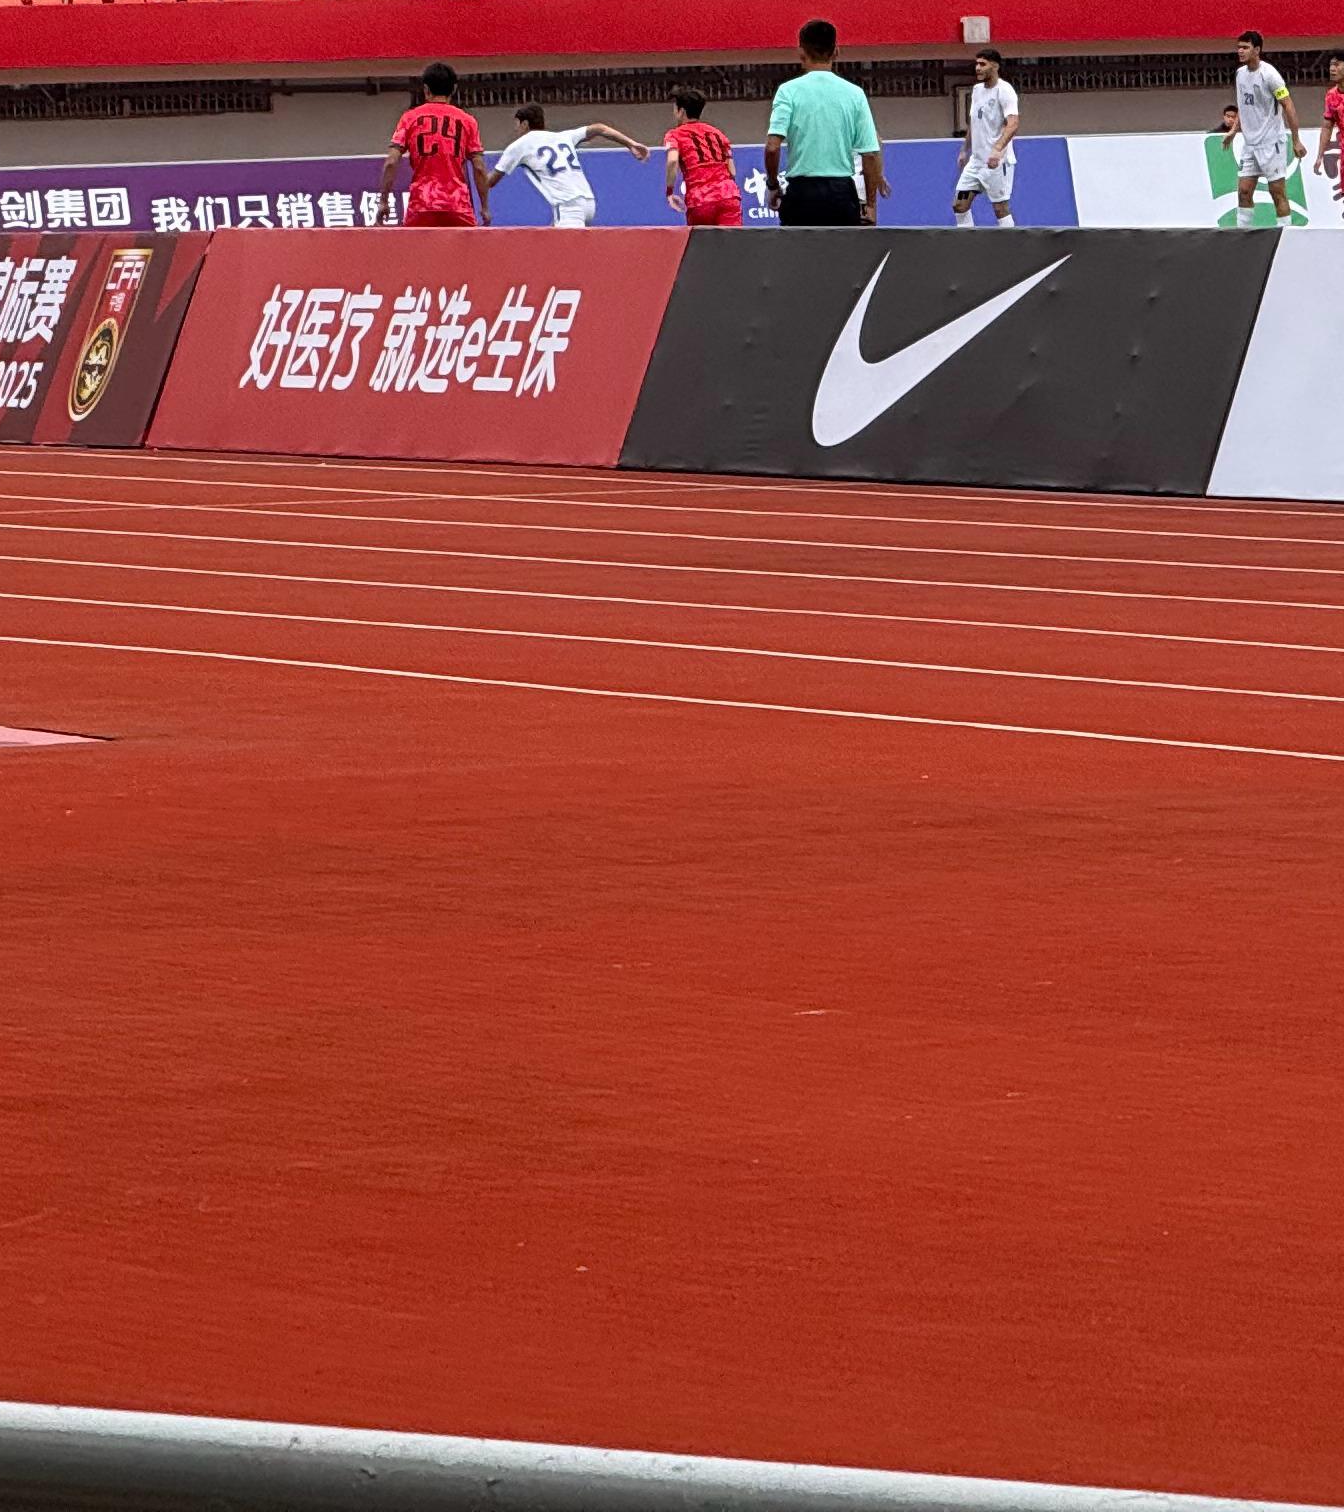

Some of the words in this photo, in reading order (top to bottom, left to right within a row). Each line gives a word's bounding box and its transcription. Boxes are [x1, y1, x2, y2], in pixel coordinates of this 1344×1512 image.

[416, 114, 463, 159] 24
[537, 143, 581, 176] 22
[239, 283, 383, 392] 好医疗
[369, 283, 582, 398] 就选e生保
